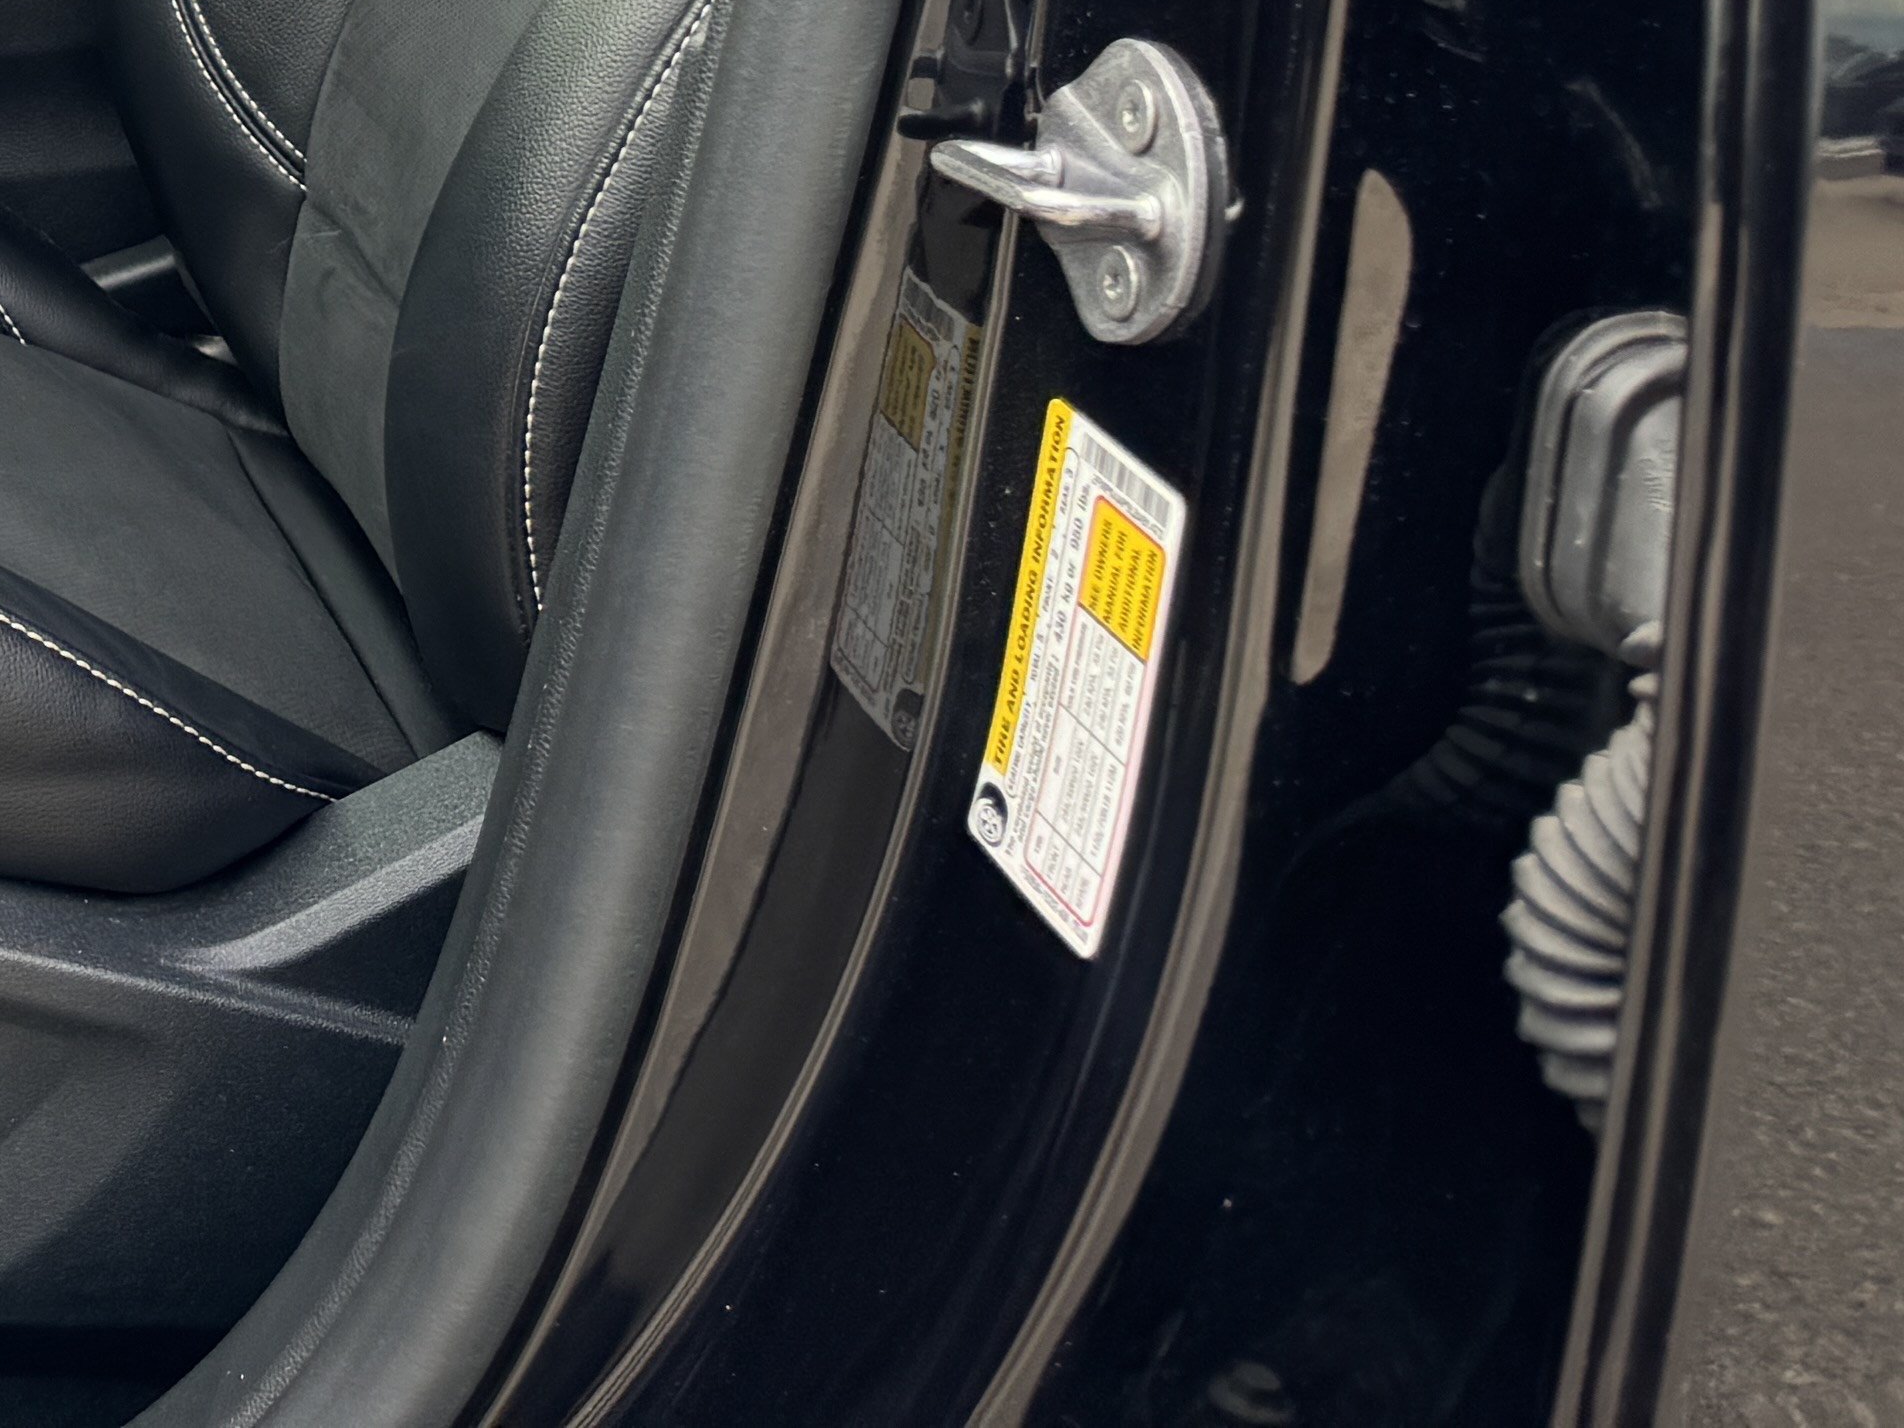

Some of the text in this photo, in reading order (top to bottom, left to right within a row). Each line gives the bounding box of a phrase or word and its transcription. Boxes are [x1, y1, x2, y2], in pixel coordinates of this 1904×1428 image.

[994, 415, 1066, 766] TIRE AND LOADING INFORMATION
[1102, 568, 1122, 624] MANUAL
[1119, 549, 1142, 633] ADDITIONAL
[1132, 550, 1158, 649] INFORMATION
